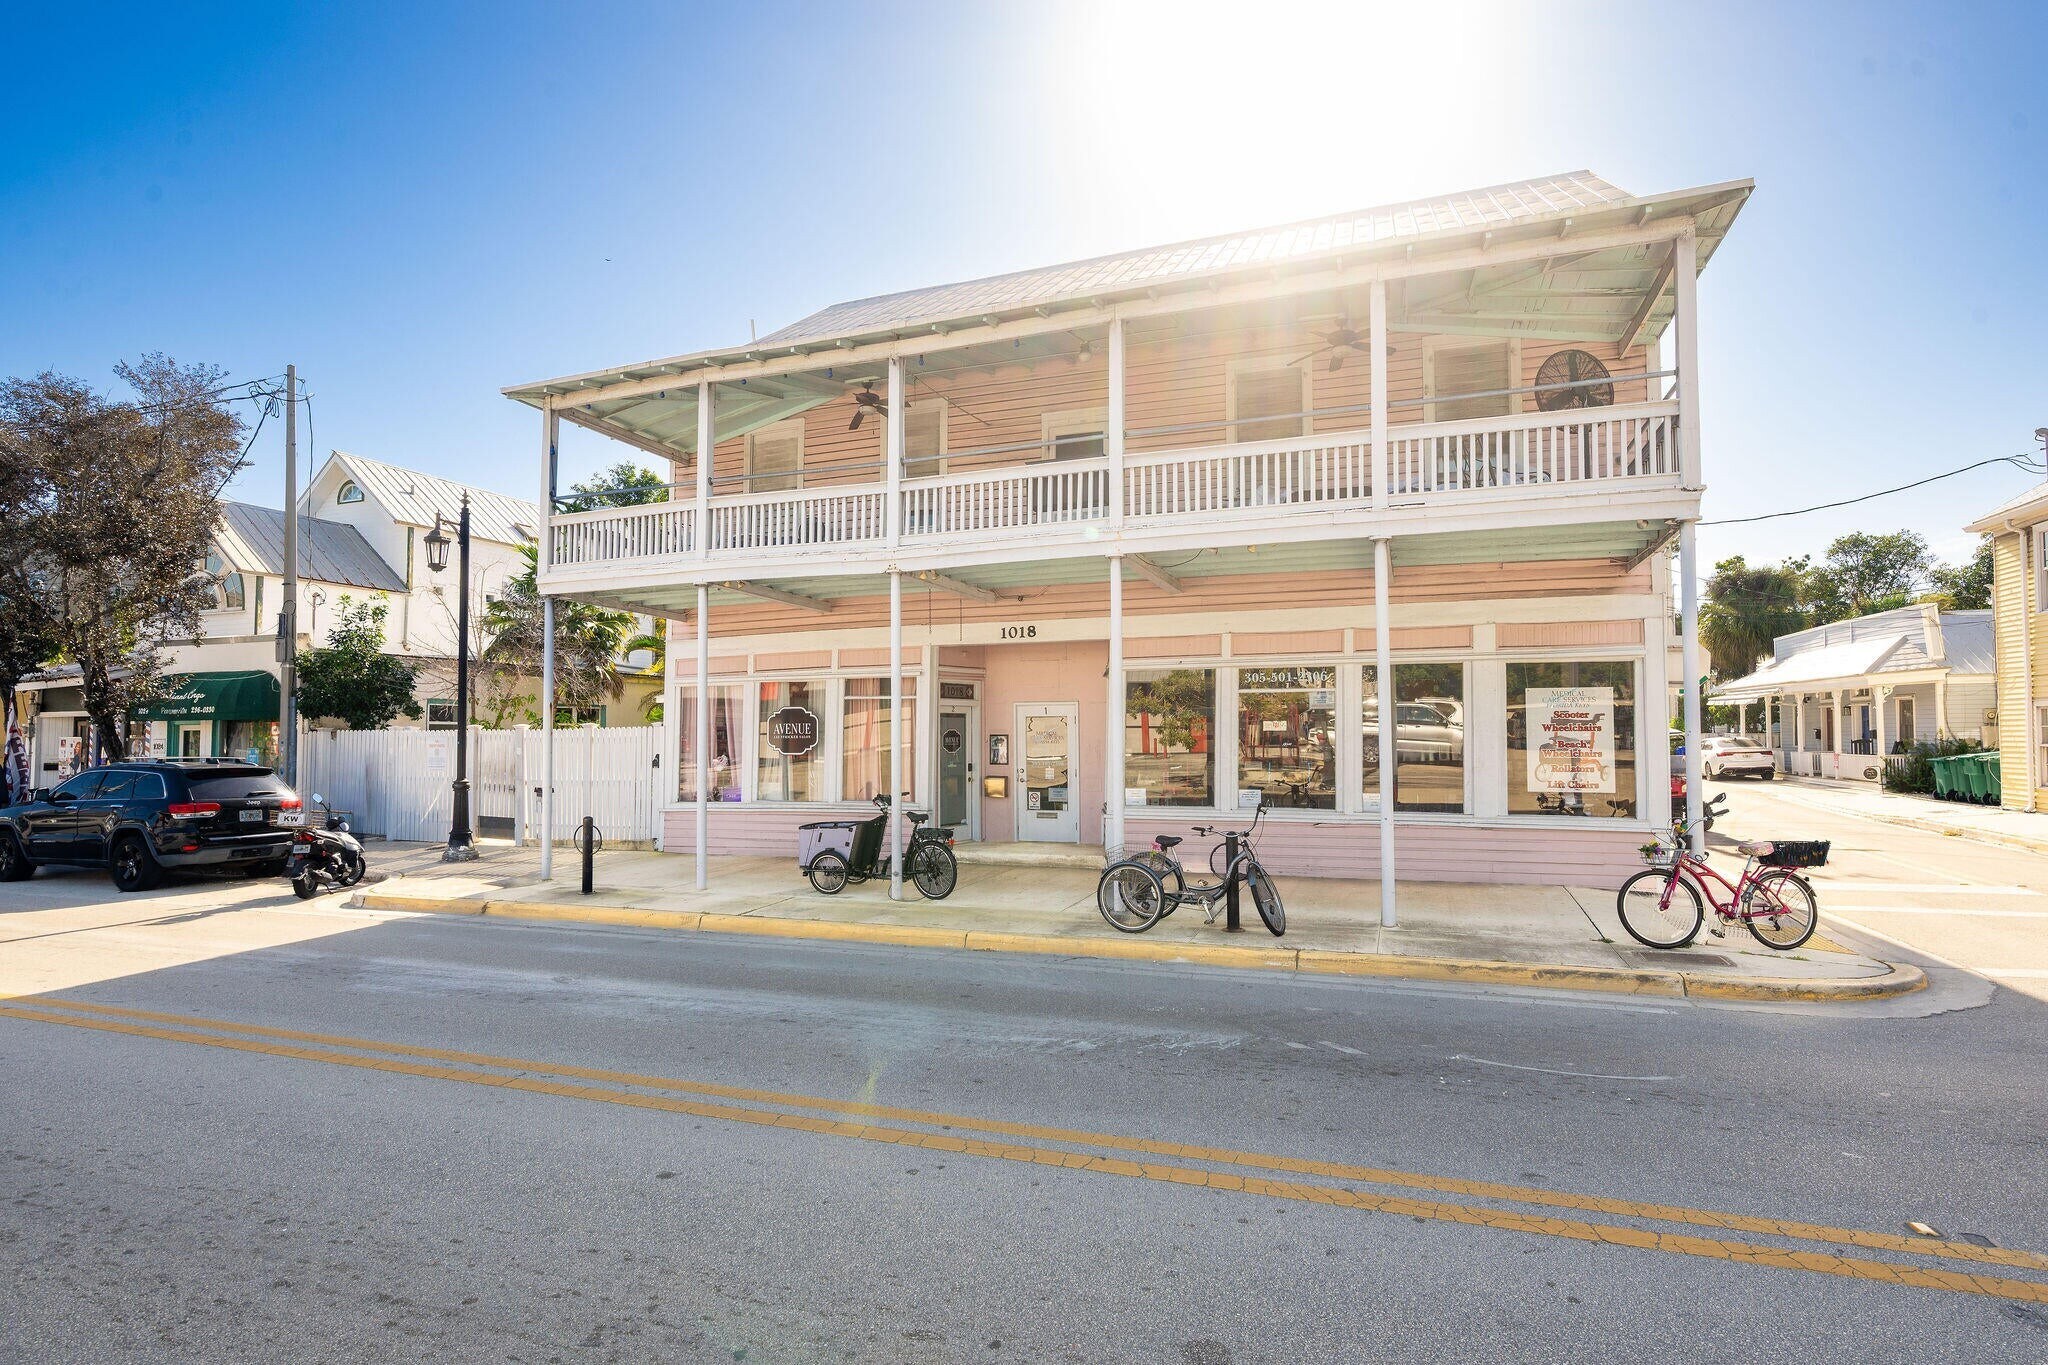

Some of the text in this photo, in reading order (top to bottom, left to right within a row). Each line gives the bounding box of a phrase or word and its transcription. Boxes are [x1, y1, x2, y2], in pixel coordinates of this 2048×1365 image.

[1001, 626, 1037, 639] 1018
[1553, 711, 1590, 719] Scooter
[773, 722, 811, 735] AVENUE
[1542, 723, 1602, 732] Wheelchairs
[1557, 740, 1587, 748] Beach
[1542, 749, 1603, 758] Wheelchairs
[1551, 764, 1595, 773] Rollators
[1547, 780, 1600, 789] Lift Chairs
